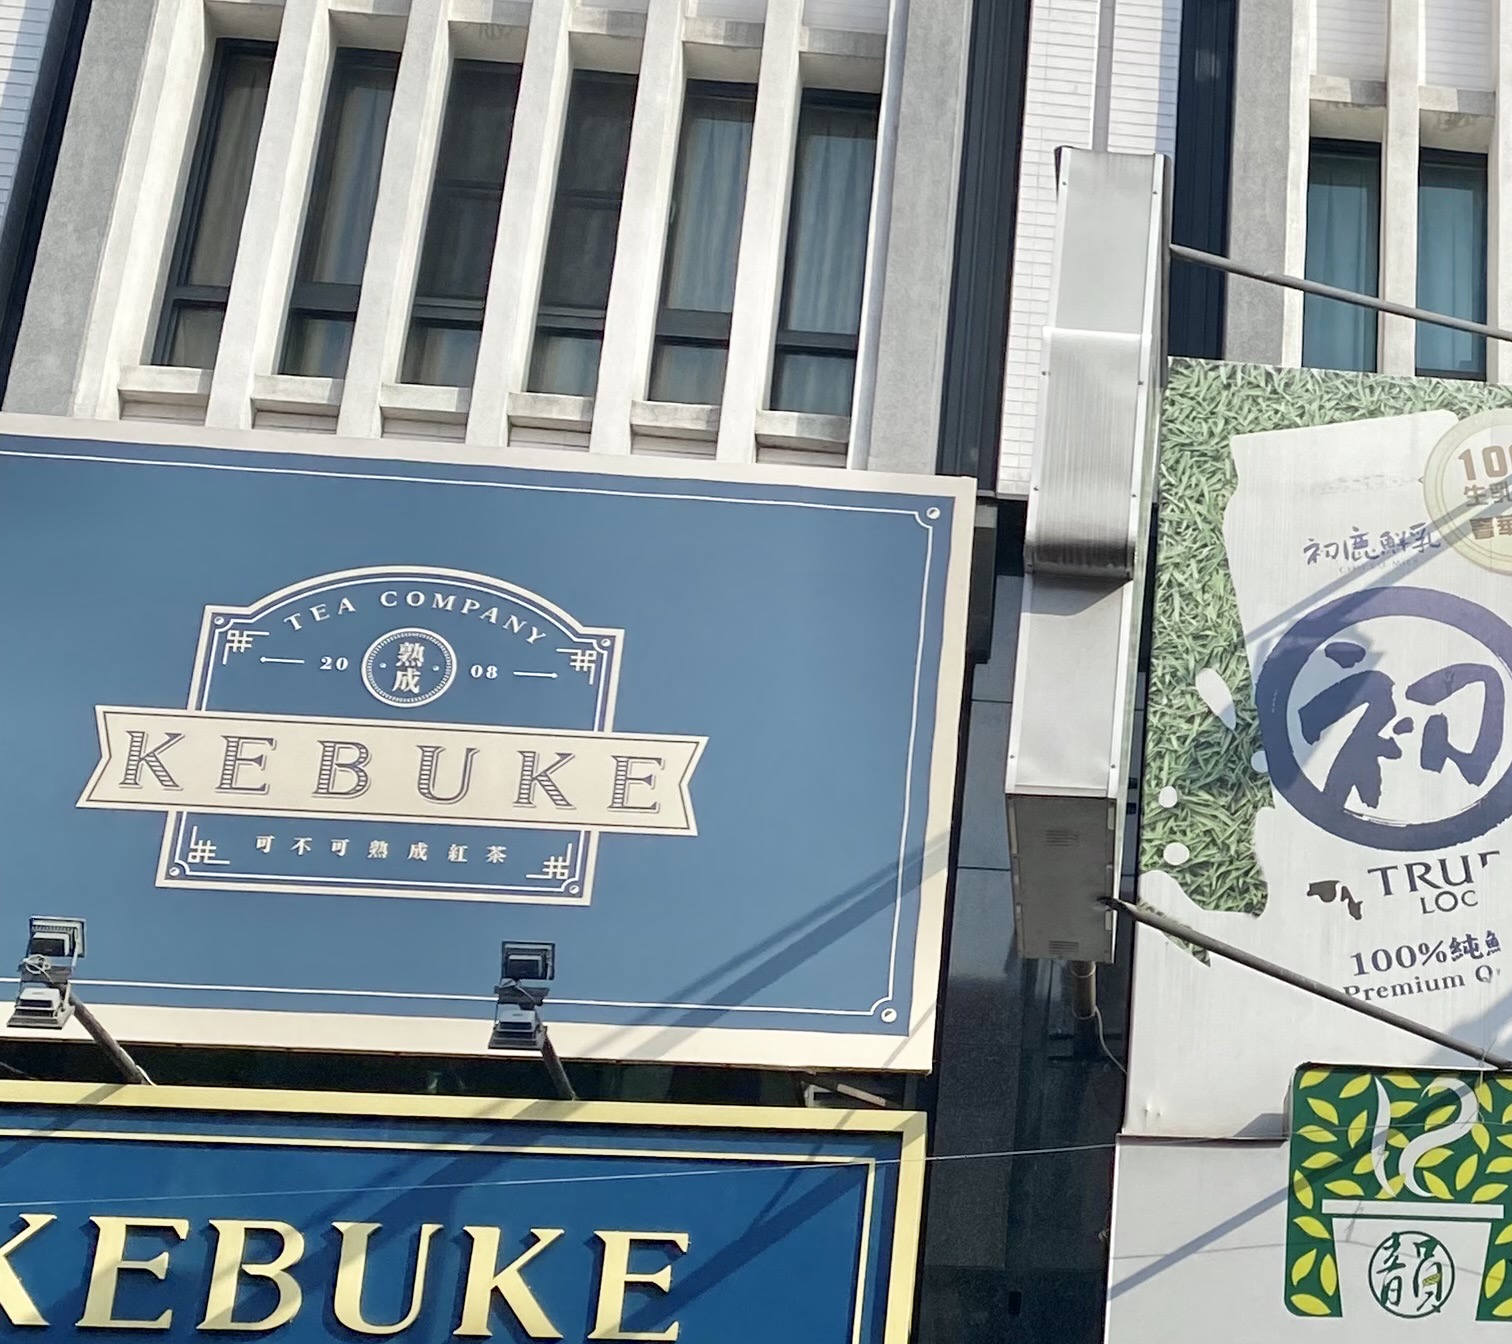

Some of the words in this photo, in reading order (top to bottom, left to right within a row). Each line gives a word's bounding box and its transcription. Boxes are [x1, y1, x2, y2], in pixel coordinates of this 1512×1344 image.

[283, 596, 358, 633] TEA
[379, 589, 549, 647] COMPANY
[319, 656, 350, 673] 20
[392, 642, 424, 695] 熟成
[470, 664, 499, 681] 08
[1299, 640, 1504, 810] 初
[118, 729, 667, 815] KEBUKE
[254, 833, 508, 865] 可不可熟成紅茶
[1342, 972, 1466, 1002] Premium
